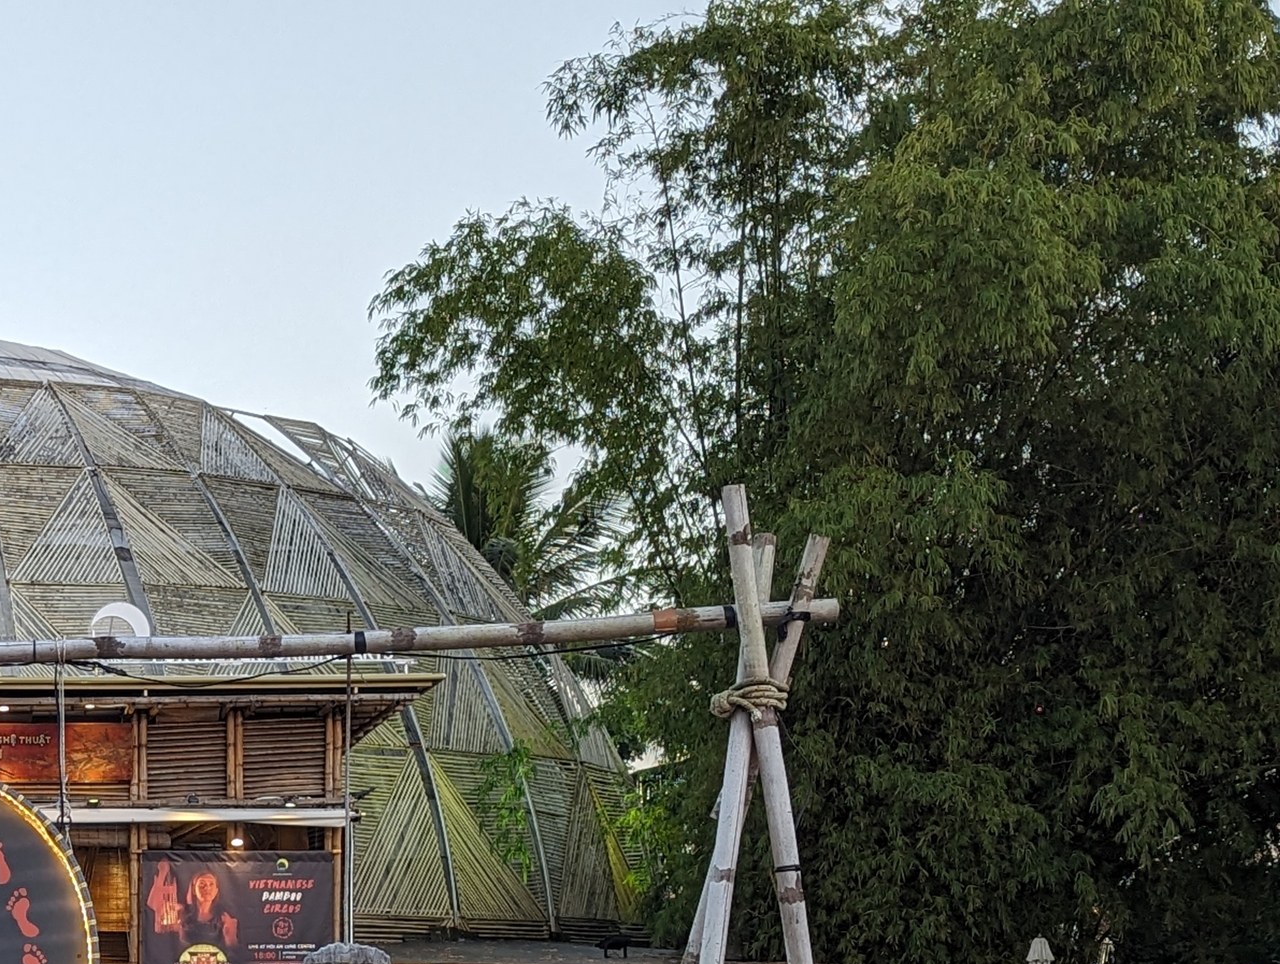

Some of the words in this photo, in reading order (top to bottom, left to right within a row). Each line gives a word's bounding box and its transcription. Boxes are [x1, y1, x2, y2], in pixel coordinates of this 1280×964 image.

[19, 734, 51, 746] THUẬT
[249, 880, 314, 889] VIETNAMESE
[262, 891, 302, 901] BAMBOO
[263, 904, 301, 913] CIRCUS
[254, 951, 276, 960] 18:00
